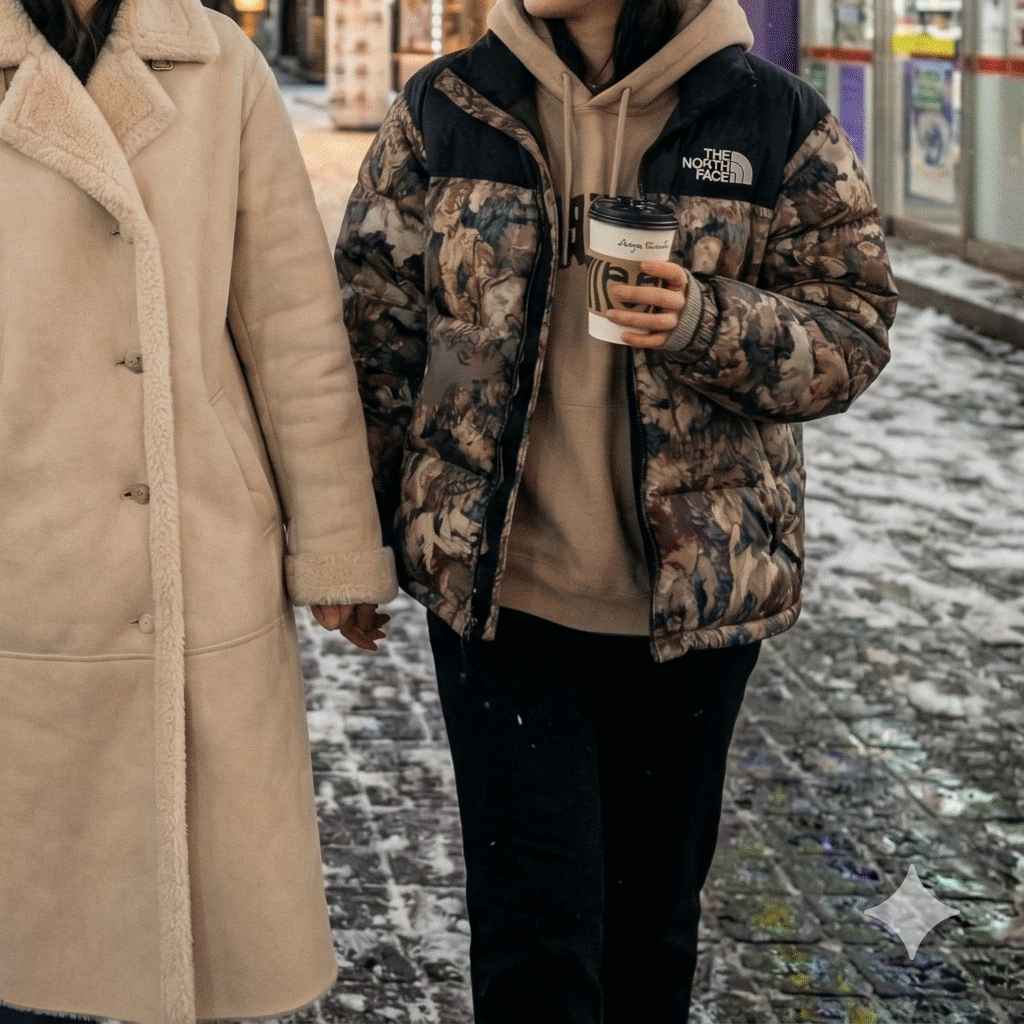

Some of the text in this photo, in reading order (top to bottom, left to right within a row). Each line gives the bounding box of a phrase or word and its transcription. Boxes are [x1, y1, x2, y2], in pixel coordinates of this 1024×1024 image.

[703, 147, 732, 162] THE
[682, 157, 731, 172] NORTH
[695, 168, 729, 183] FACE
